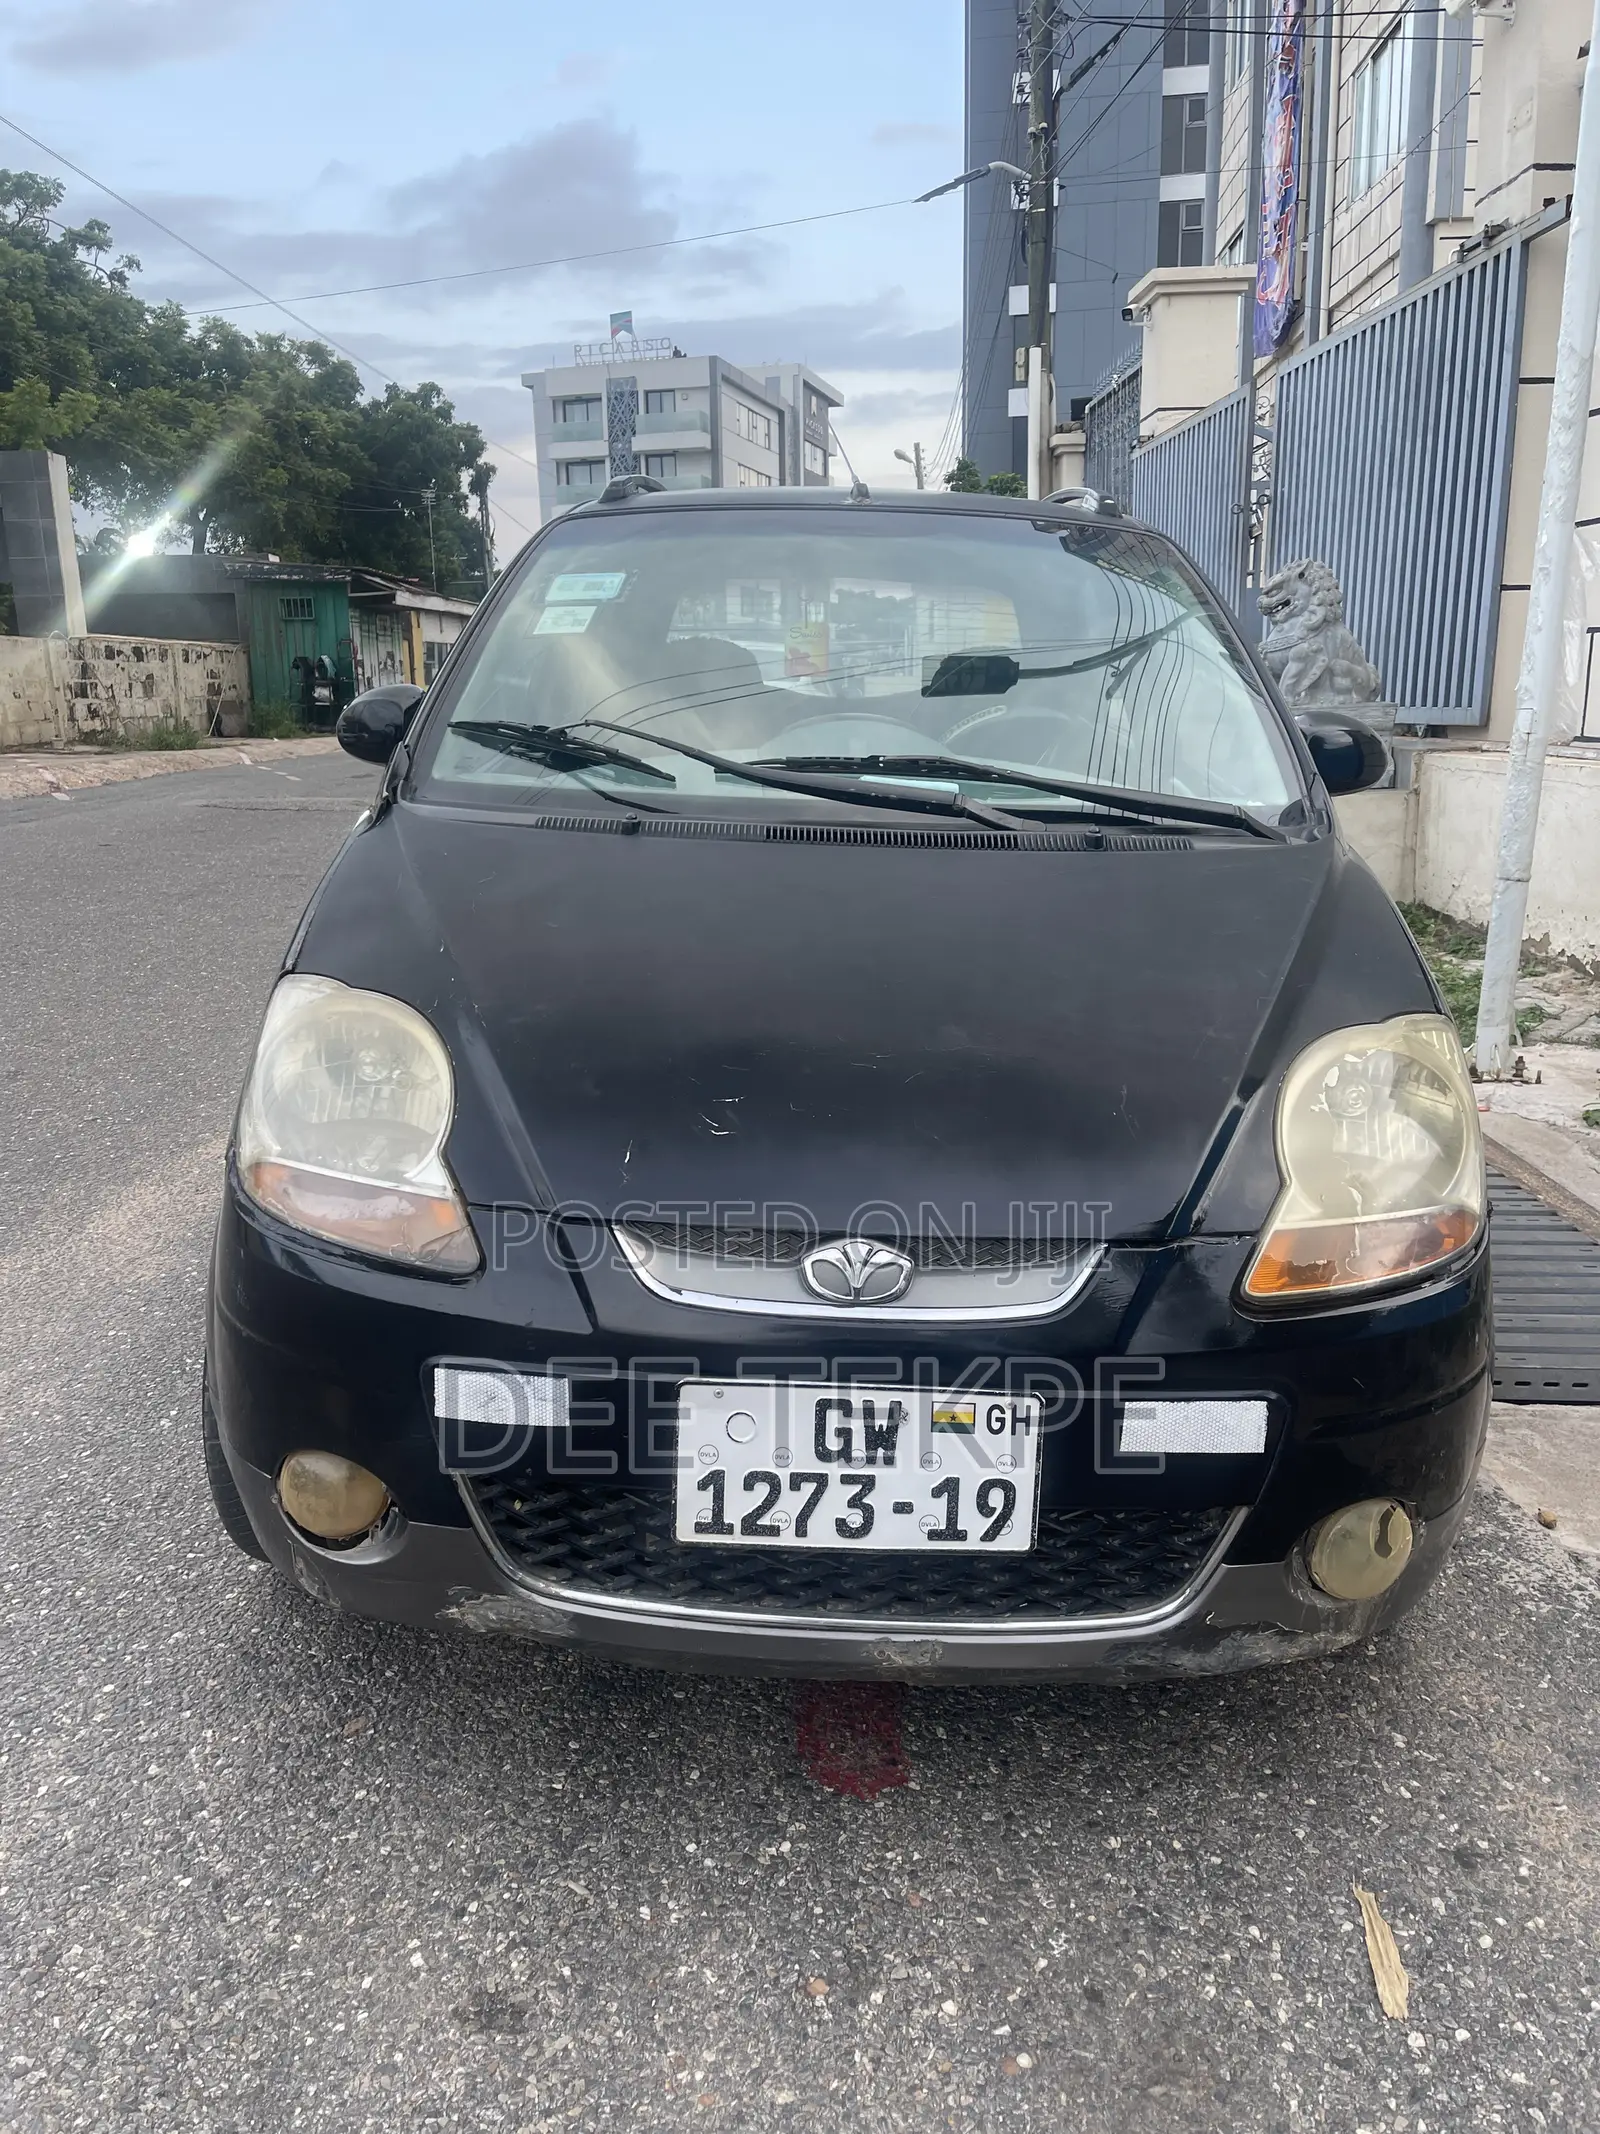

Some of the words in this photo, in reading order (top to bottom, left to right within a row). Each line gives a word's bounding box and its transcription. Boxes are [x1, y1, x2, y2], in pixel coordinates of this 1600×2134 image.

[814, 1398, 903, 1465] GW
[986, 1403, 1031, 1436] GH
[694, 1469, 1016, 1542] 1273-19
